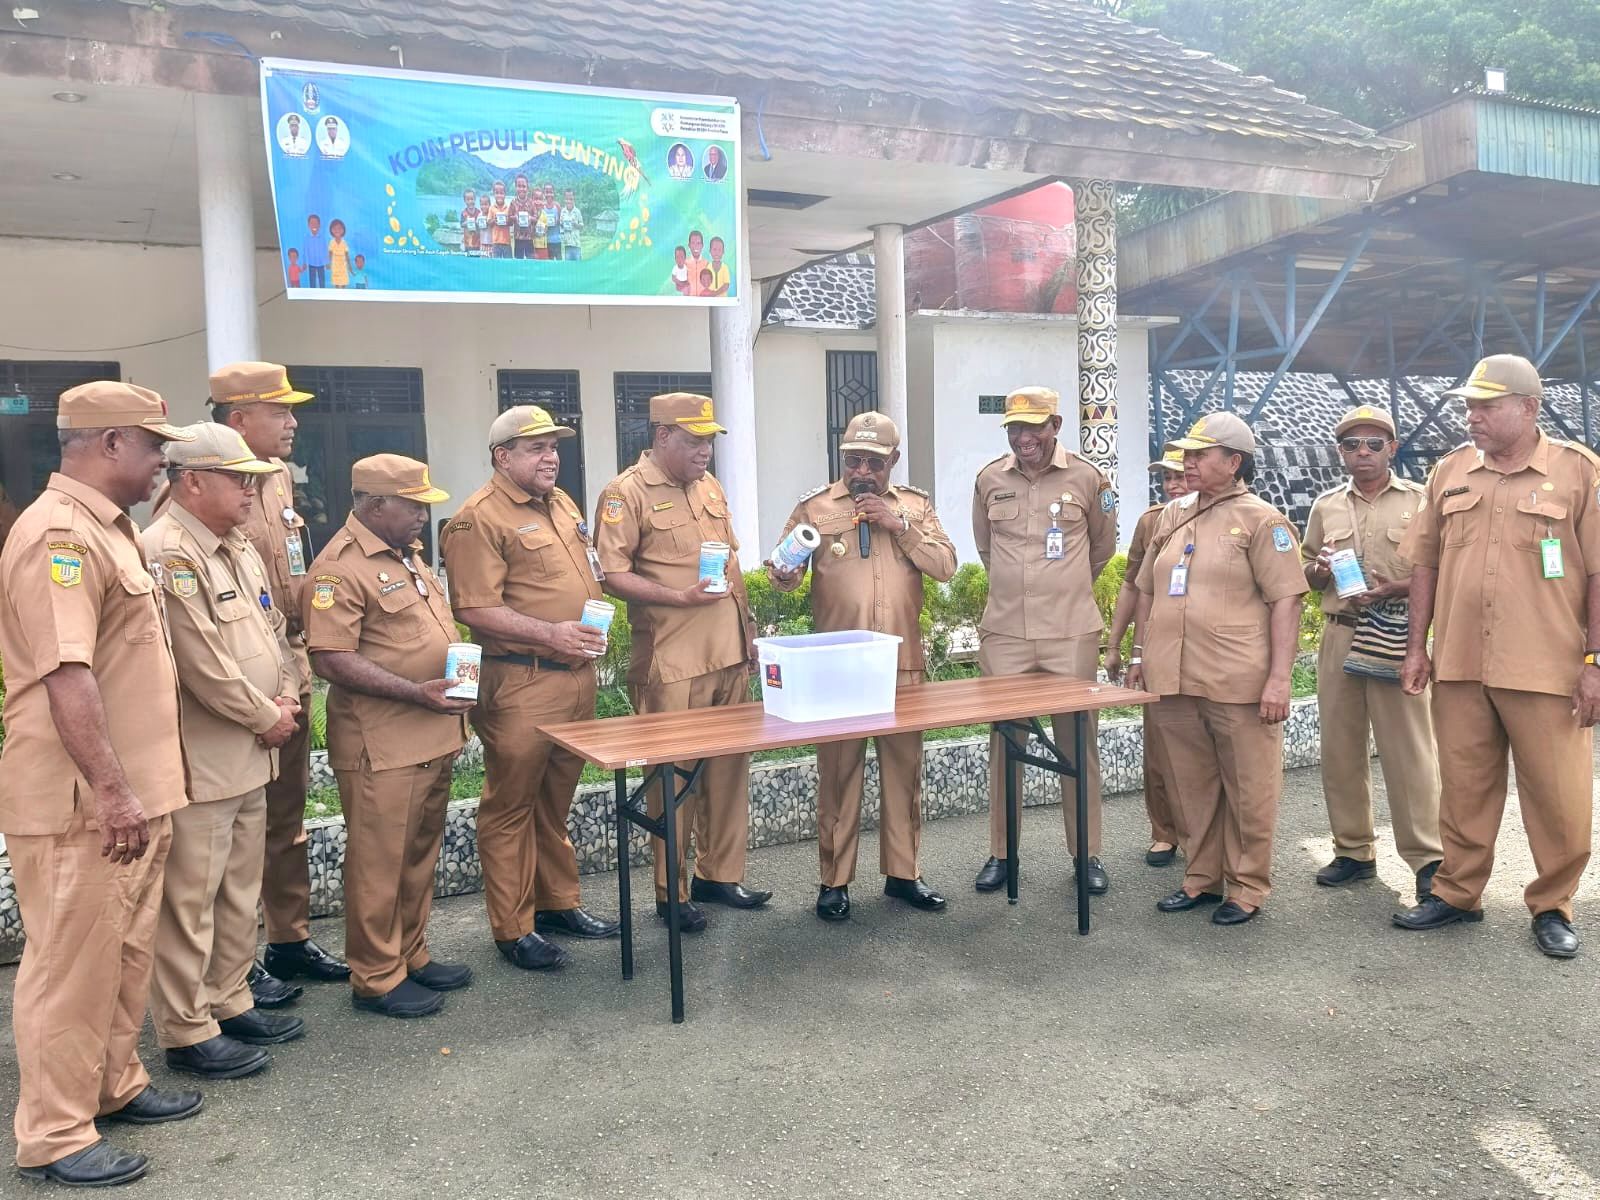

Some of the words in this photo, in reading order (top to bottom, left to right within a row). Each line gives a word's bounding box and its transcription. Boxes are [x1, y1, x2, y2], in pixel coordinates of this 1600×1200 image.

[388, 136, 446, 176] KOIN
[449, 127, 528, 155] PEDULI
[532, 130, 641, 192] STUNTING
